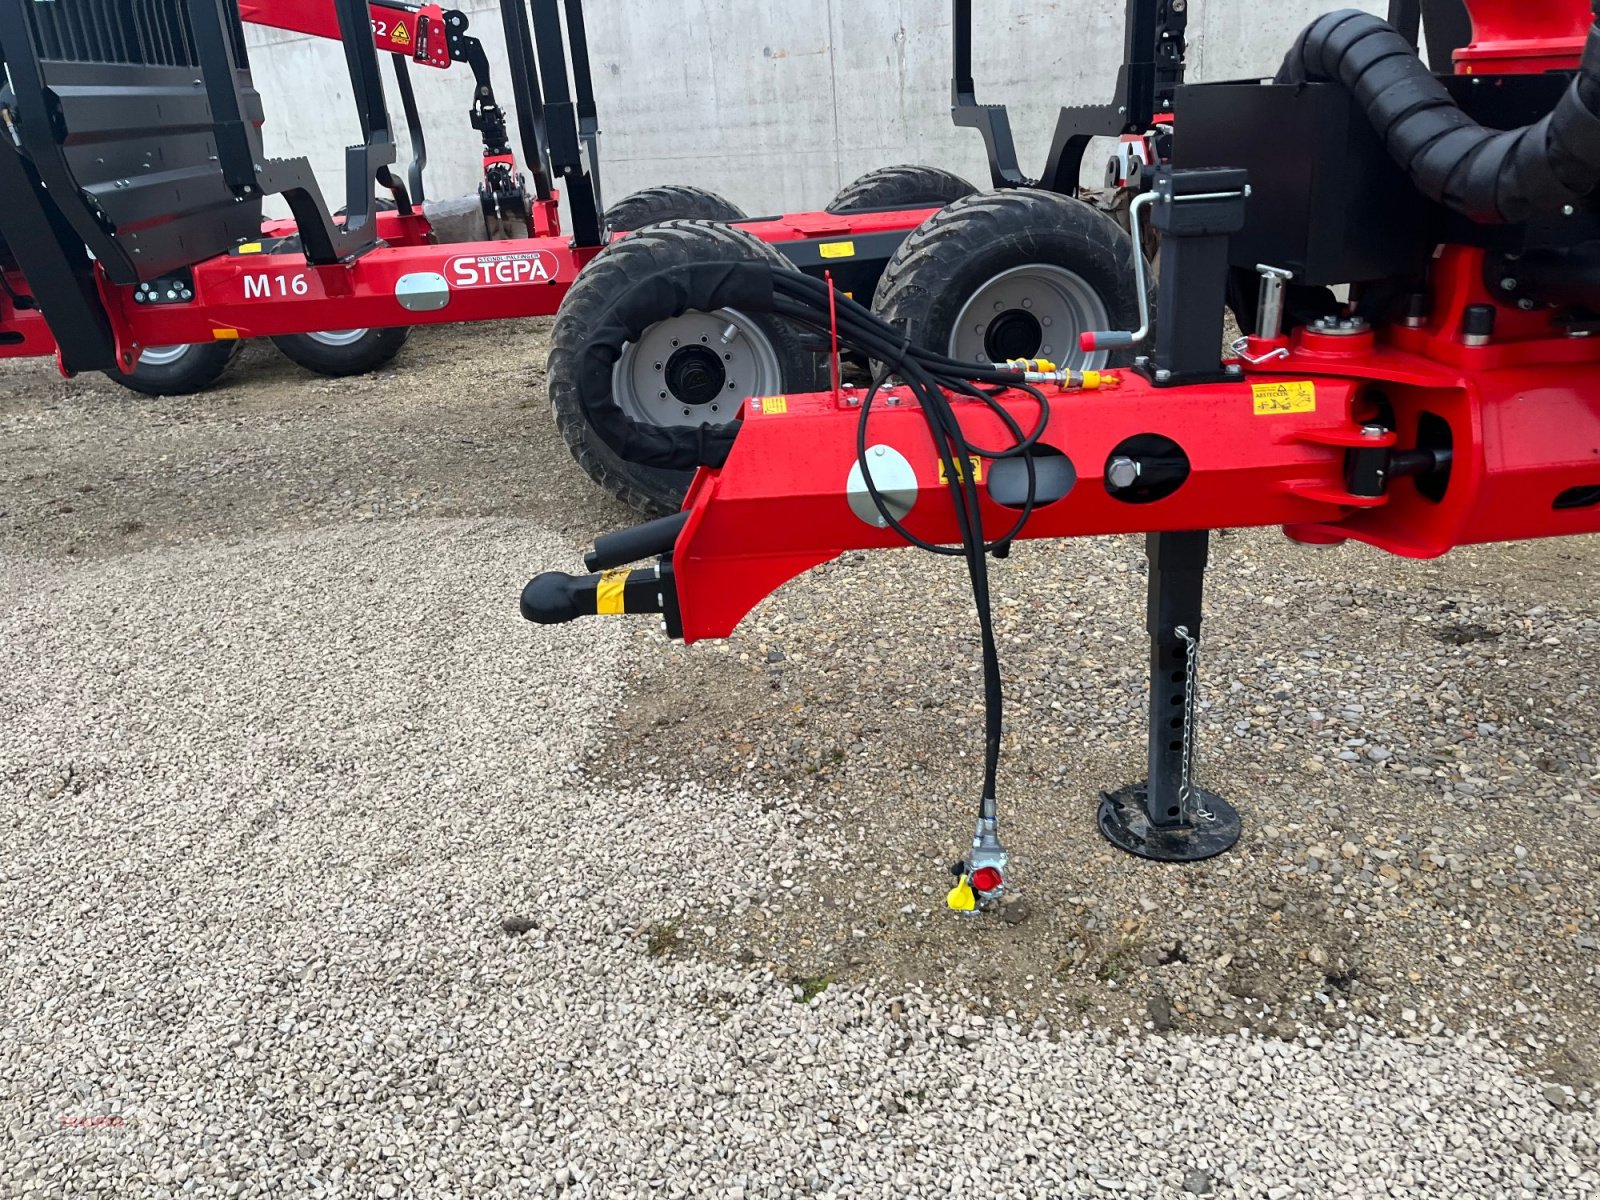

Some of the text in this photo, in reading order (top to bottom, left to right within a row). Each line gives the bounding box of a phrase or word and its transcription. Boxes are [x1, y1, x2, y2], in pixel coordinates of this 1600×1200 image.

[453, 257, 549, 286] STEPA
[243, 273, 308, 298] M 16
